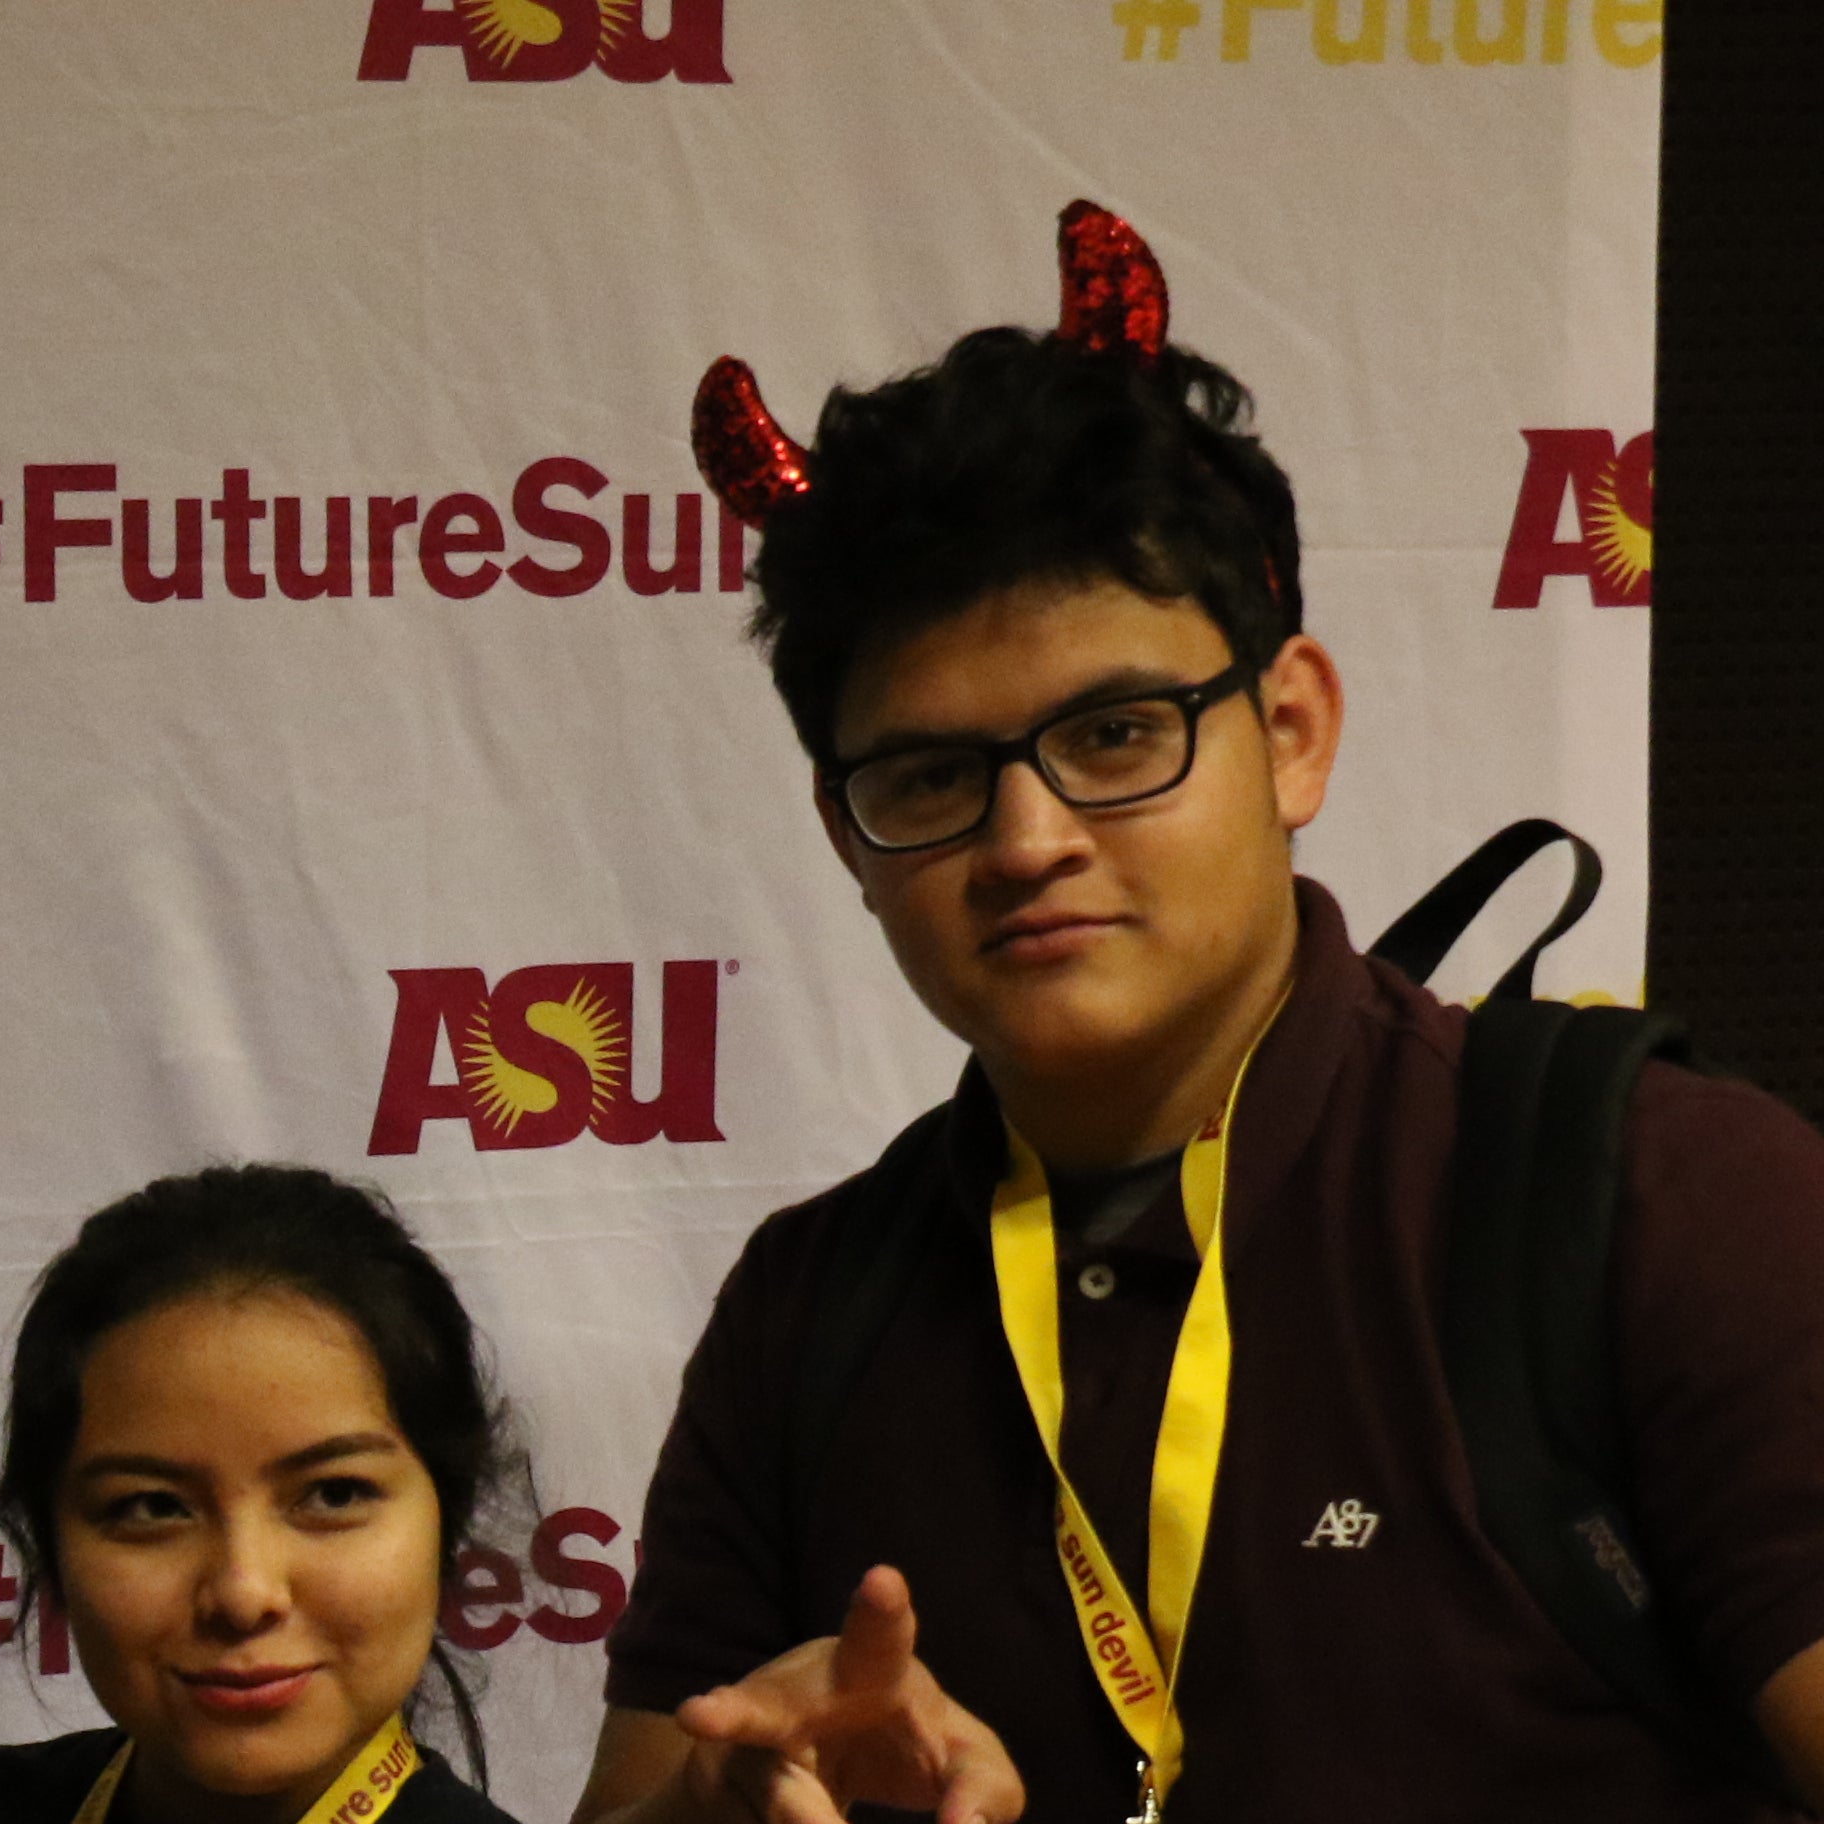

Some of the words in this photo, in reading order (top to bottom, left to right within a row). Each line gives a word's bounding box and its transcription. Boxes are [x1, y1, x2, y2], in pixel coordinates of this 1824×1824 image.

[366, 959, 728, 1156] ASU
[1061, 1533, 1105, 1605] sun
[1090, 1611, 1156, 1705] devil
